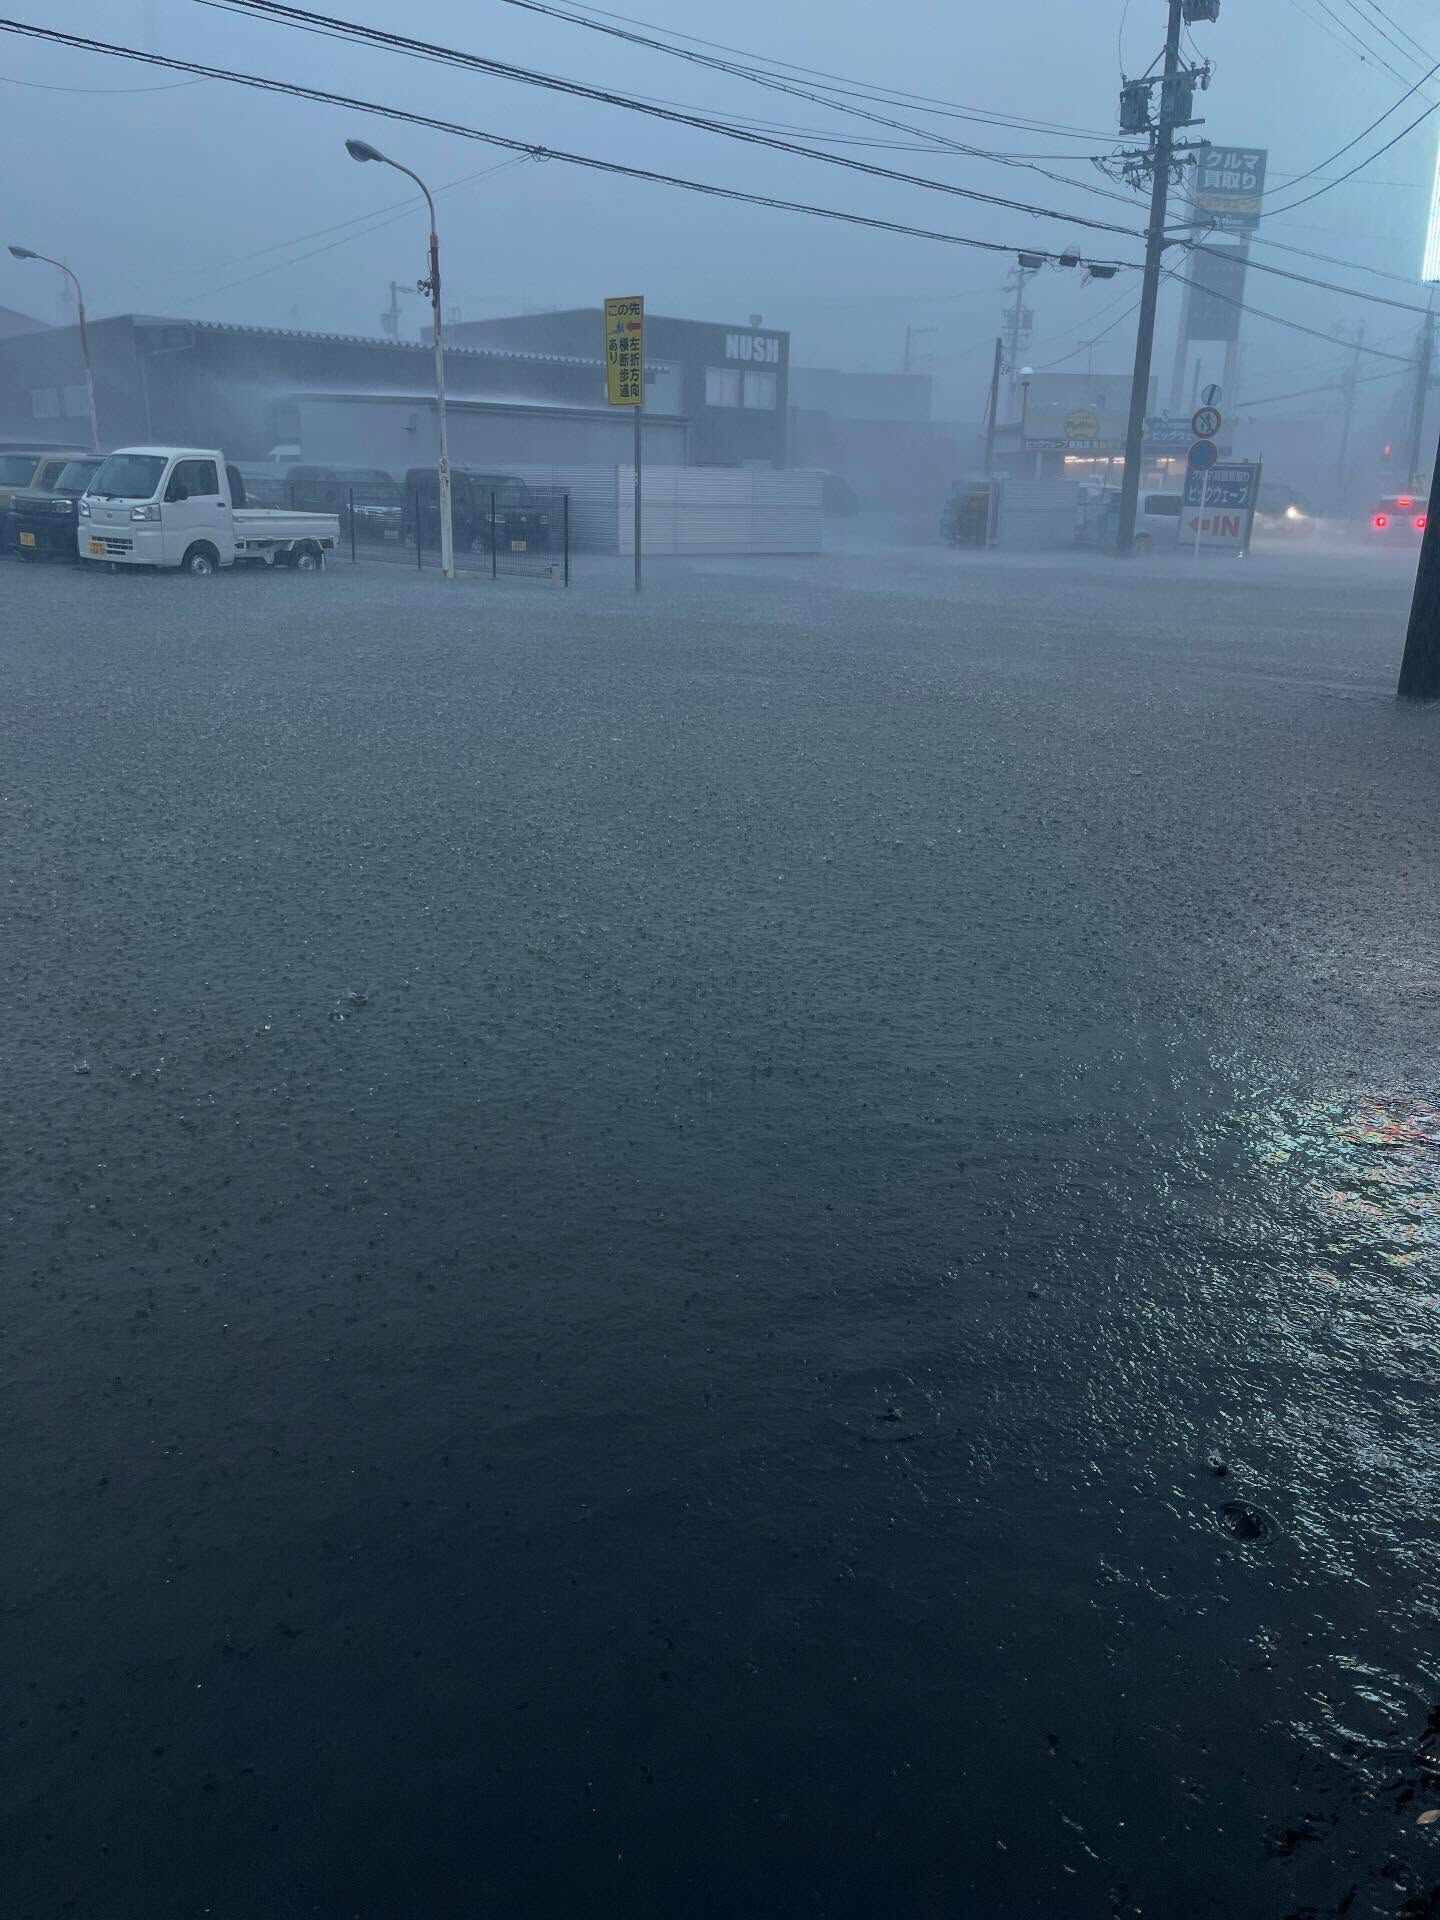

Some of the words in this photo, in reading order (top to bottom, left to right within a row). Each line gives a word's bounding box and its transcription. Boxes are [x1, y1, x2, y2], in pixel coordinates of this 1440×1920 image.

[1206, 152, 1260, 169] クルマ
[1204, 169, 1257, 190] 買取り
[608, 303, 640, 317] この先
[609, 338, 618, 365] あり
[726, 335, 779, 363] NUSH
[619, 337, 630, 398] 横断歩道
[630, 337, 640, 397] 左折方向
[1211, 514, 1240, 537] IN
